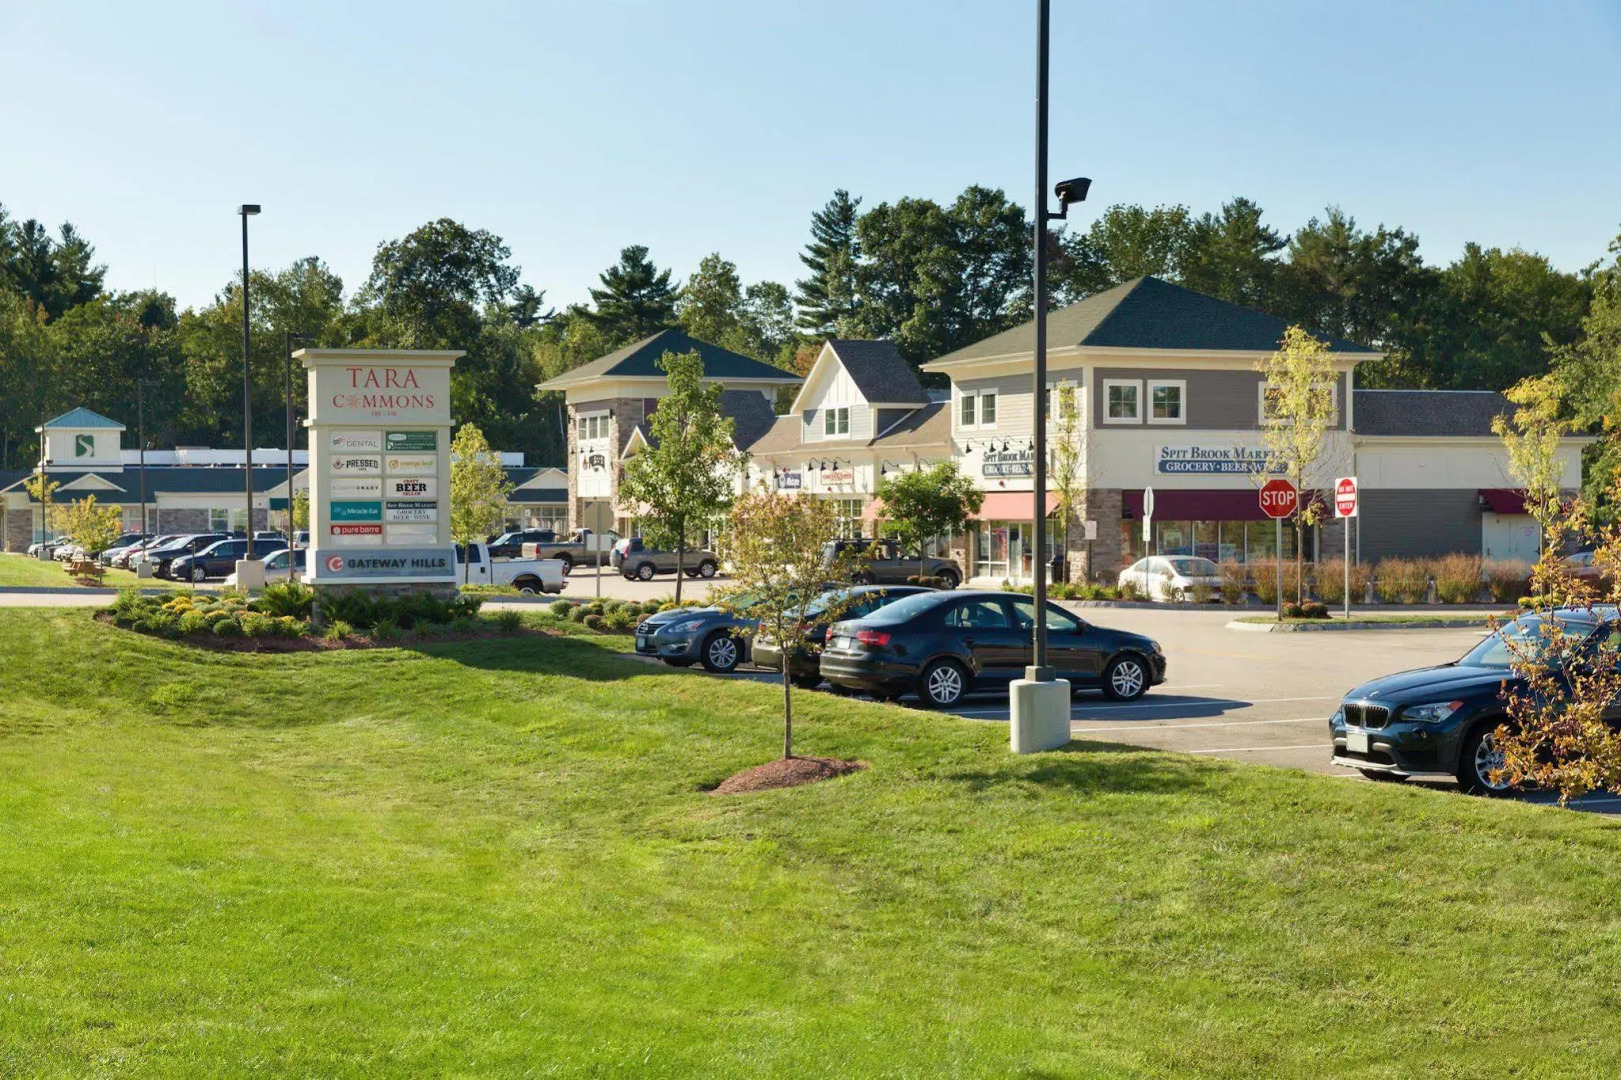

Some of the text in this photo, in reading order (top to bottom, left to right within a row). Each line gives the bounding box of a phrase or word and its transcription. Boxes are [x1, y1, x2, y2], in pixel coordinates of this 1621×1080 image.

[346, 368, 420, 388] TARA
[346, 459, 379, 469] PRESSED
[1166, 461, 1216, 471] GROCERY
[1221, 461, 1248, 471] BEER
[396, 483, 427, 492] BEER
[1262, 490, 1295, 506] STOP
[342, 525, 380, 534] pure barre
[348, 558, 446, 568] GATEWAY HILLS
